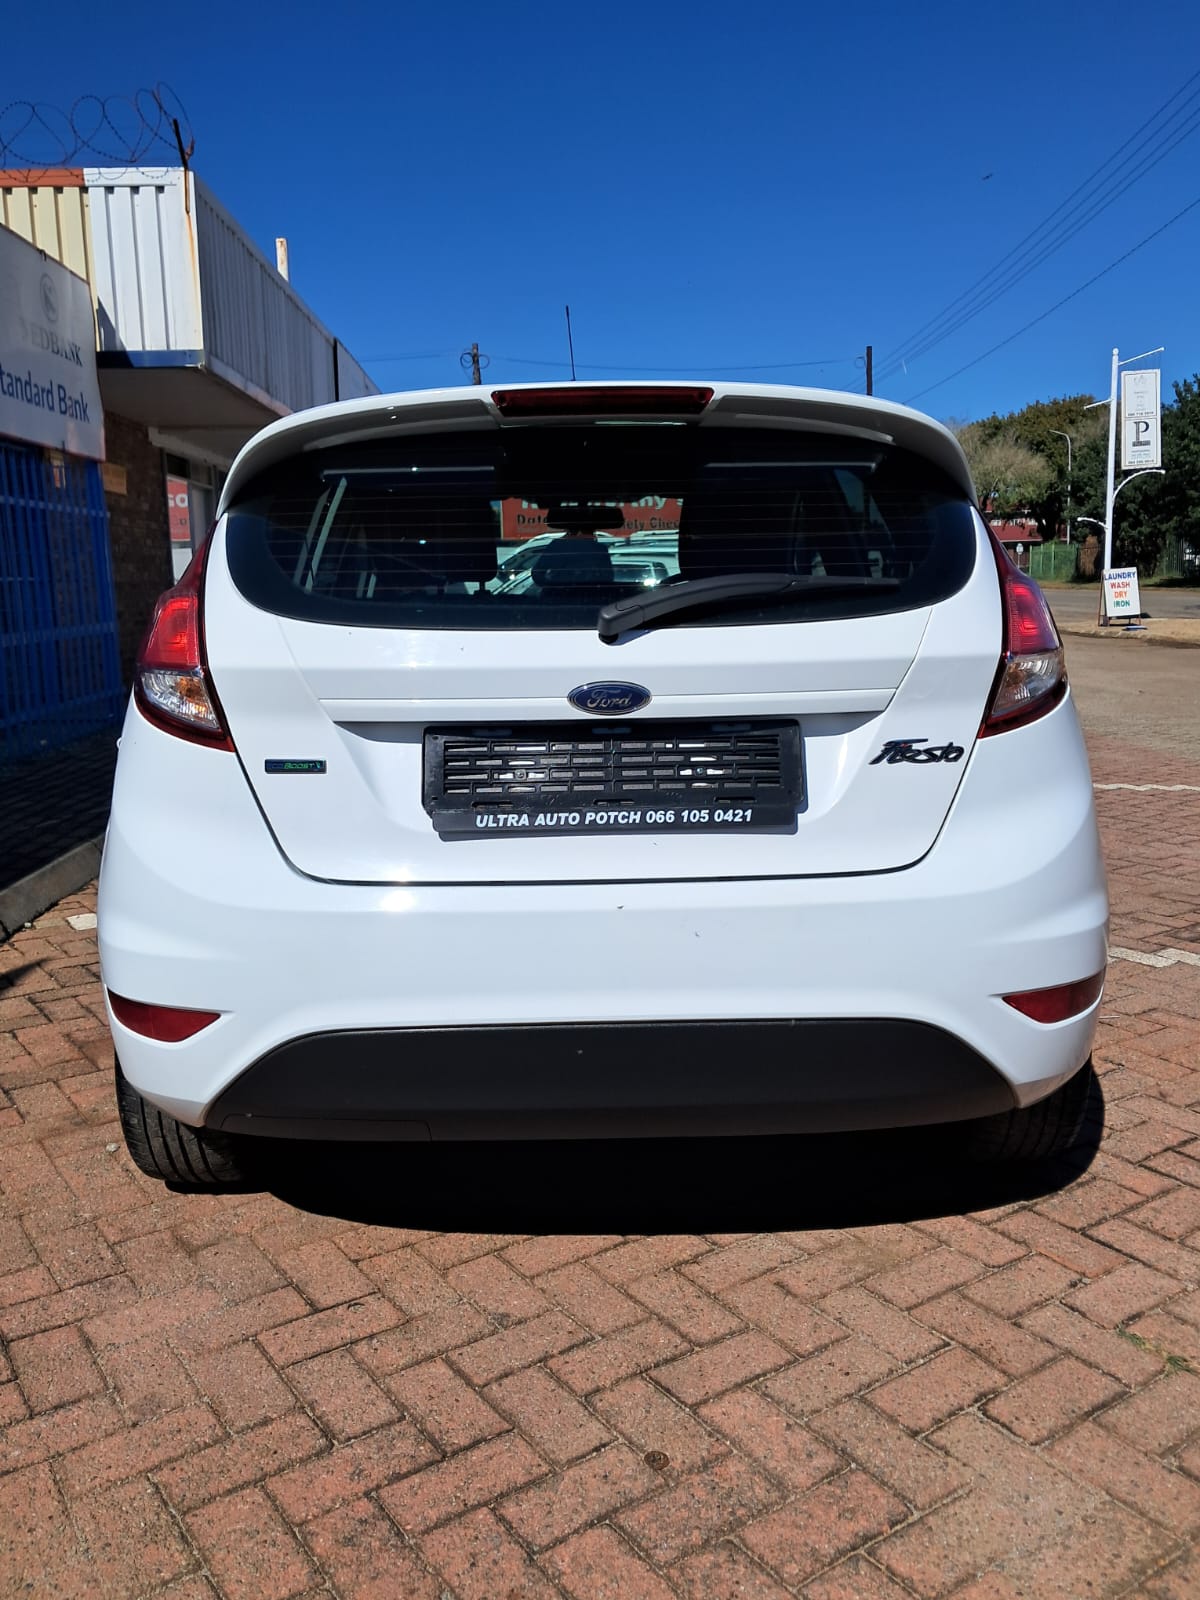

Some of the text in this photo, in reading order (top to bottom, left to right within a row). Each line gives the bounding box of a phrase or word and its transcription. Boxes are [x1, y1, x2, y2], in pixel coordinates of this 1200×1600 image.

[0, 363, 90, 423] tandard Bank
[1104, 571, 1136, 580] LAUNDRY
[1110, 581, 1131, 589] WASH
[1114, 591, 1127, 599] DRY
[1113, 600, 1131, 608] IRON
[586, 688, 632, 708] Ford
[868, 738, 964, 765] Fiesta
[475, 809, 753, 828] ULTRA AUTO POTCH 066 105 0421
